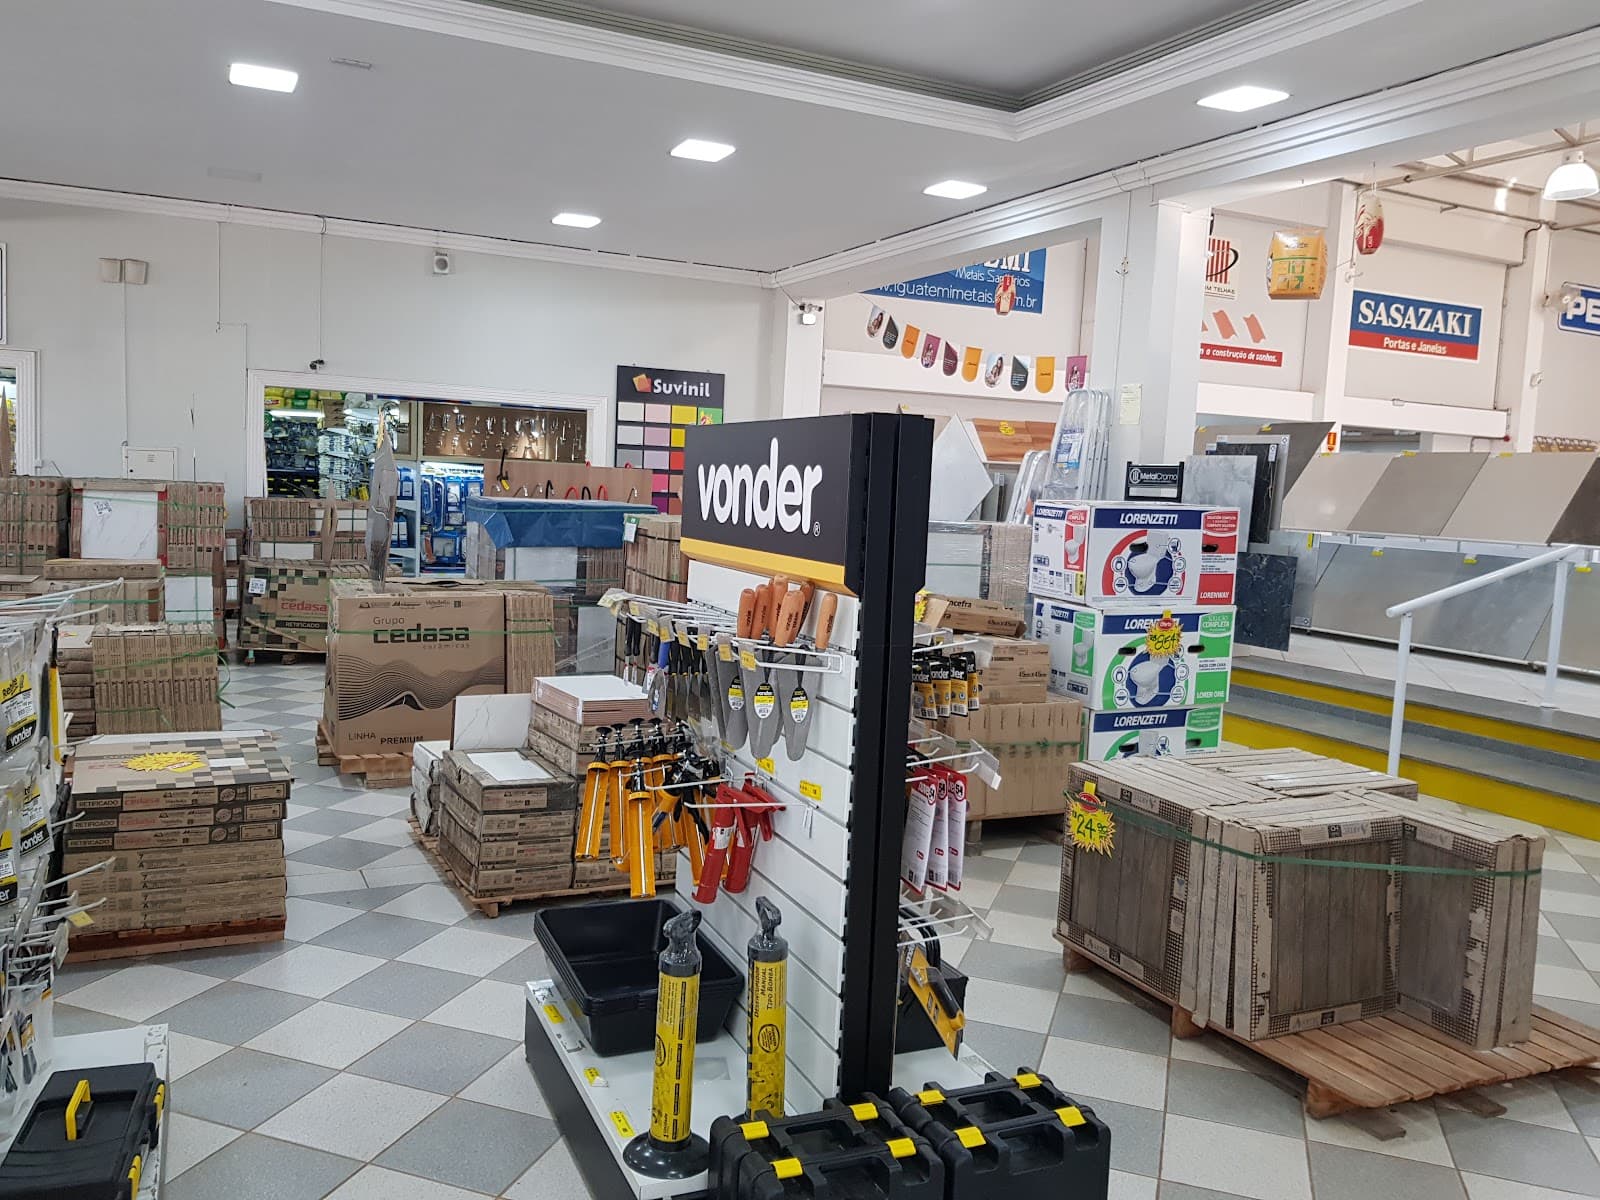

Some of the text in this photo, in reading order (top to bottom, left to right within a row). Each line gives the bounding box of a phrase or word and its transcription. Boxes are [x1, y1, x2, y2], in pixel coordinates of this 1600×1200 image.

[955, 267, 985, 281] Metais
[1358, 299, 1473, 338] SASAZAKI
[1383, 337, 1447, 355] Portas e Janelas
[1212, 349, 1247, 359] construção
[1248, 351, 1255, 360] de
[653, 379, 710, 398] Suvinil
[1140, 472, 1178, 481] MetalCromo
[698, 437, 823, 535] vonder
[1119, 512, 1178, 526] LORENZETTI
[1200, 591, 1230, 599] LORENWAY
[281, 601, 328, 612] cedasa
[373, 616, 405, 626] Grupo
[1124, 618, 1180, 630] LOREN
[373, 624, 470, 644] cedasa
[1114, 713, 1168, 728] LORENZETTI
[10, 724, 33, 747] vonder
[348, 732, 424, 745] LINHA PREMIUM
[956, 783, 964, 796] 54
[74, 820, 116, 828] RETIFICADO
[20, 829, 44, 851] vonder
[70, 839, 110, 847] RETIFICADO
